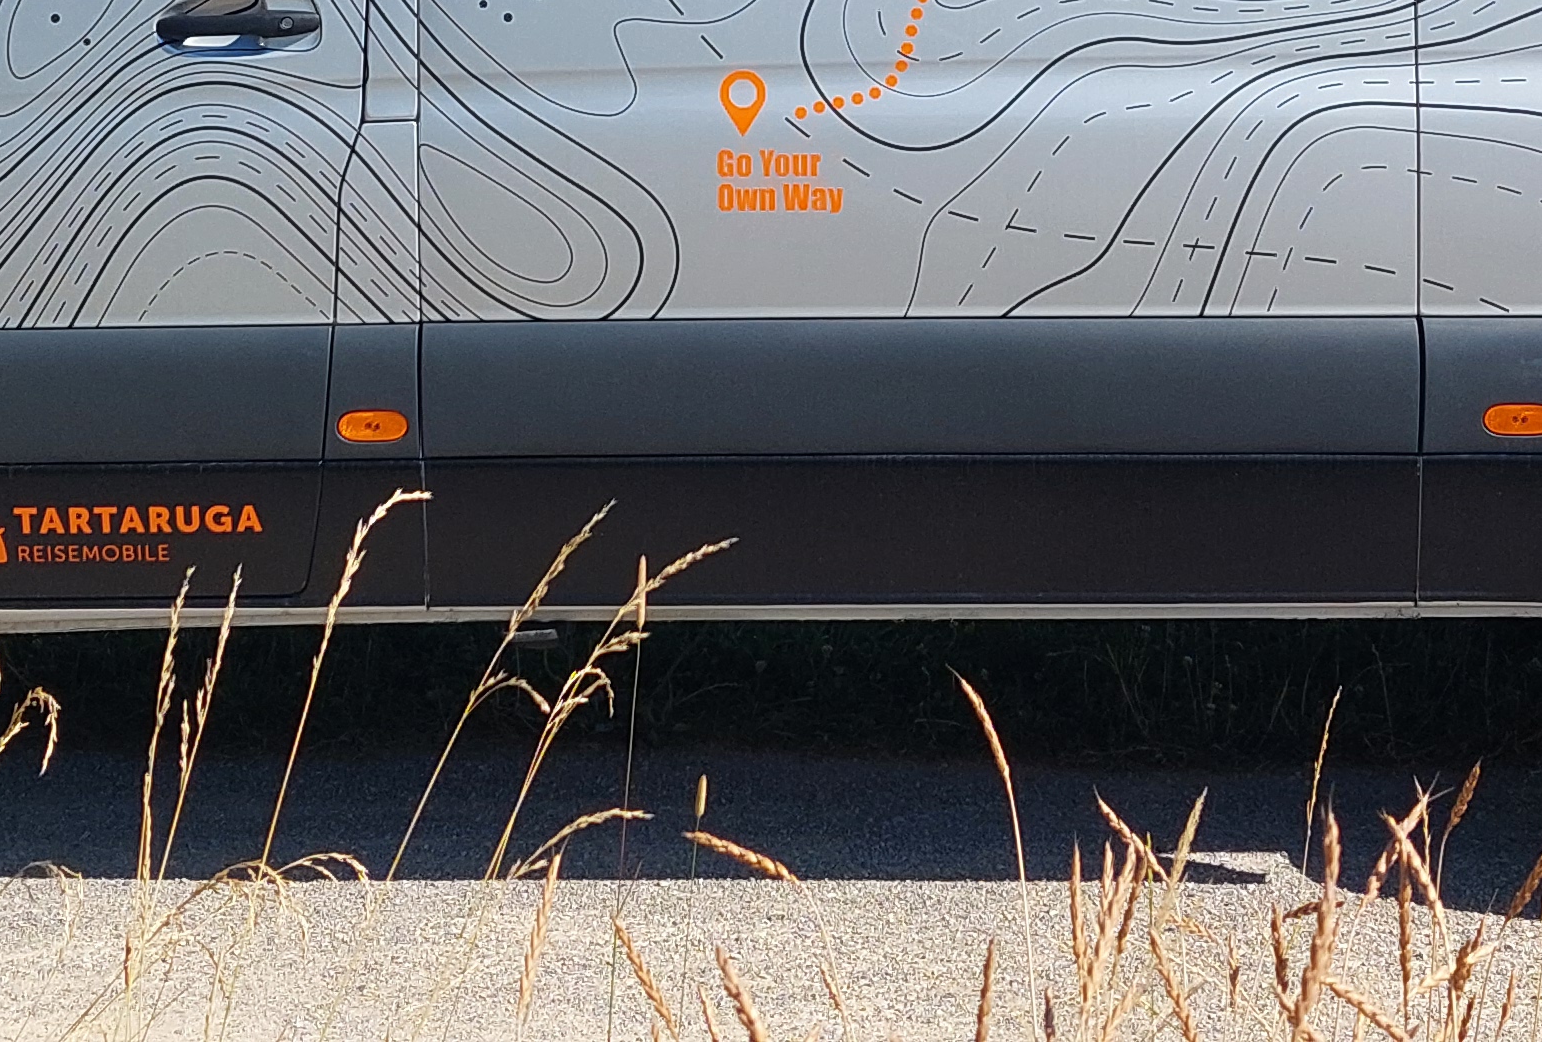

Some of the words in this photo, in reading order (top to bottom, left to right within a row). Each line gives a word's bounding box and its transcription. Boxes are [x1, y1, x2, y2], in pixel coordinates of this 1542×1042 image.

[716, 149, 753, 178] Go
[759, 149, 822, 177] Your
[717, 183, 776, 212] Own
[782, 183, 844, 214] Way
[13, 505, 263, 535] TARTARUGA
[17, 543, 171, 562] REISEMOBILE
